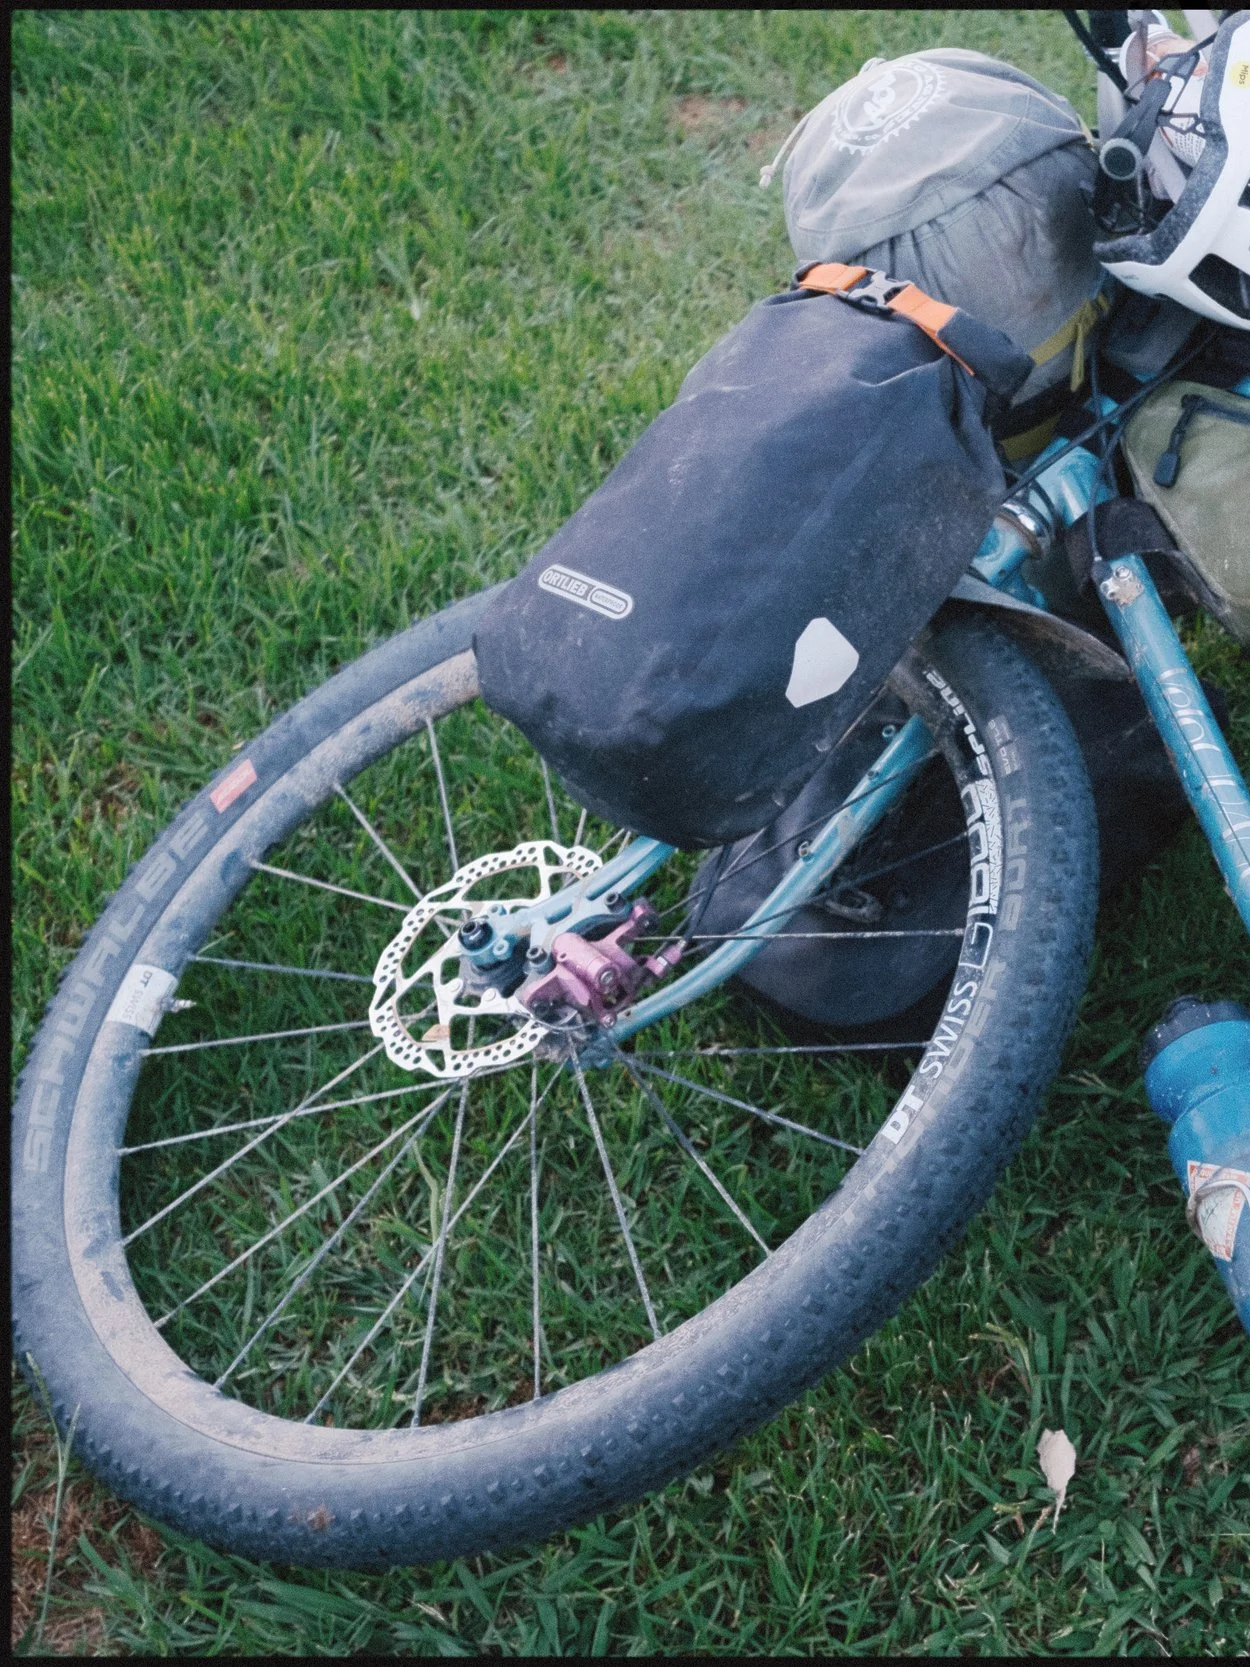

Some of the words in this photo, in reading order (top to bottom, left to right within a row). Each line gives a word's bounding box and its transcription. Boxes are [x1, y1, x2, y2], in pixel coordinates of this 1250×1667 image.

[543, 570, 588, 597] ORTLIEB
[23, 816, 209, 1172] SCHWALBE
[882, 1085, 924, 1145] DT
[919, 980, 978, 1079] SWISS
